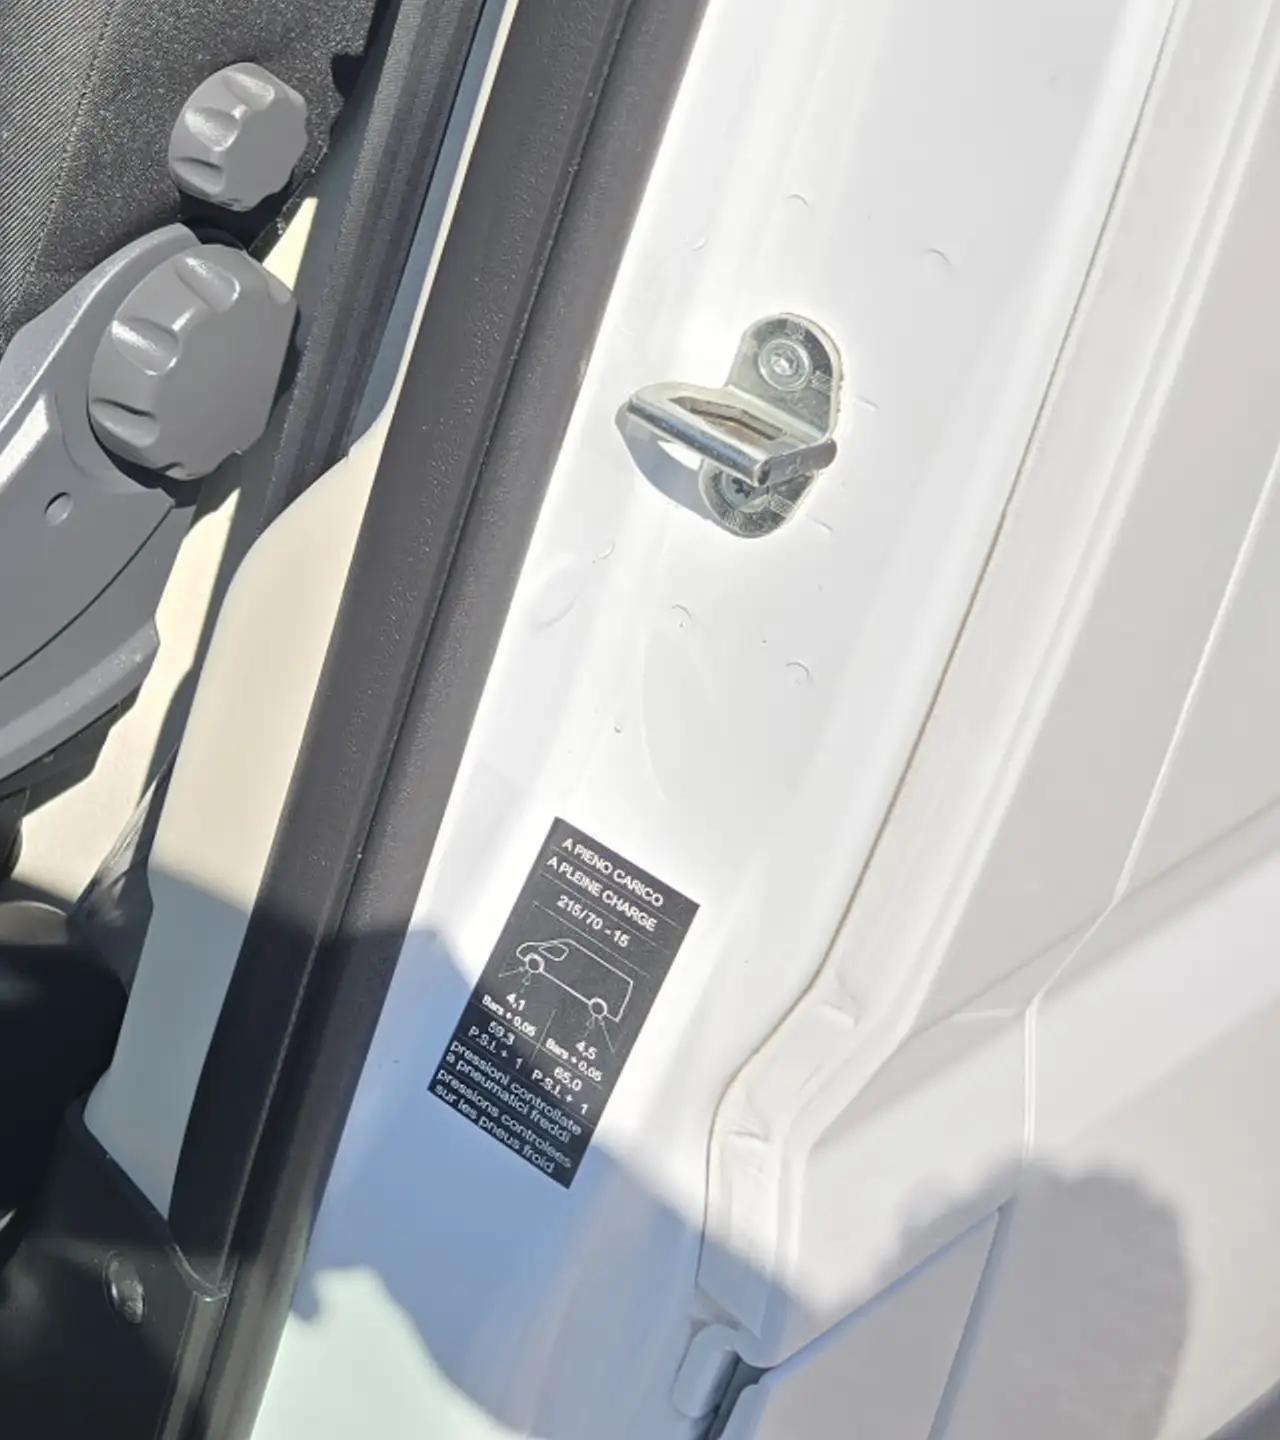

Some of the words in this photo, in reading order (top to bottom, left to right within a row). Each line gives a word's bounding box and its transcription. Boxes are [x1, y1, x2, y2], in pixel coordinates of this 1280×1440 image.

[561, 838, 573, 852] A
[573, 843, 613, 875] PIENO
[612, 869, 664, 907] CARICO
[546, 856, 558, 870] A
[558, 861, 603, 897] PLEINE
[601, 890, 658, 932] CHARGE
[613, 930, 630, 948] 15
[482, 994, 505, 1016] Bars
[506, 993, 526, 1011] 4,1
[545, 1038, 569, 1060] Bars
[575, 1040, 597, 1060] 4,5
[515, 1057, 523, 1069] 1
[434, 1084, 458, 1103] sur
[457, 1098, 478, 1120] les
[478, 1115, 521, 1150] pneus
[581, 1103, 589, 1115] 1
[529, 1109, 571, 1143] freddi
